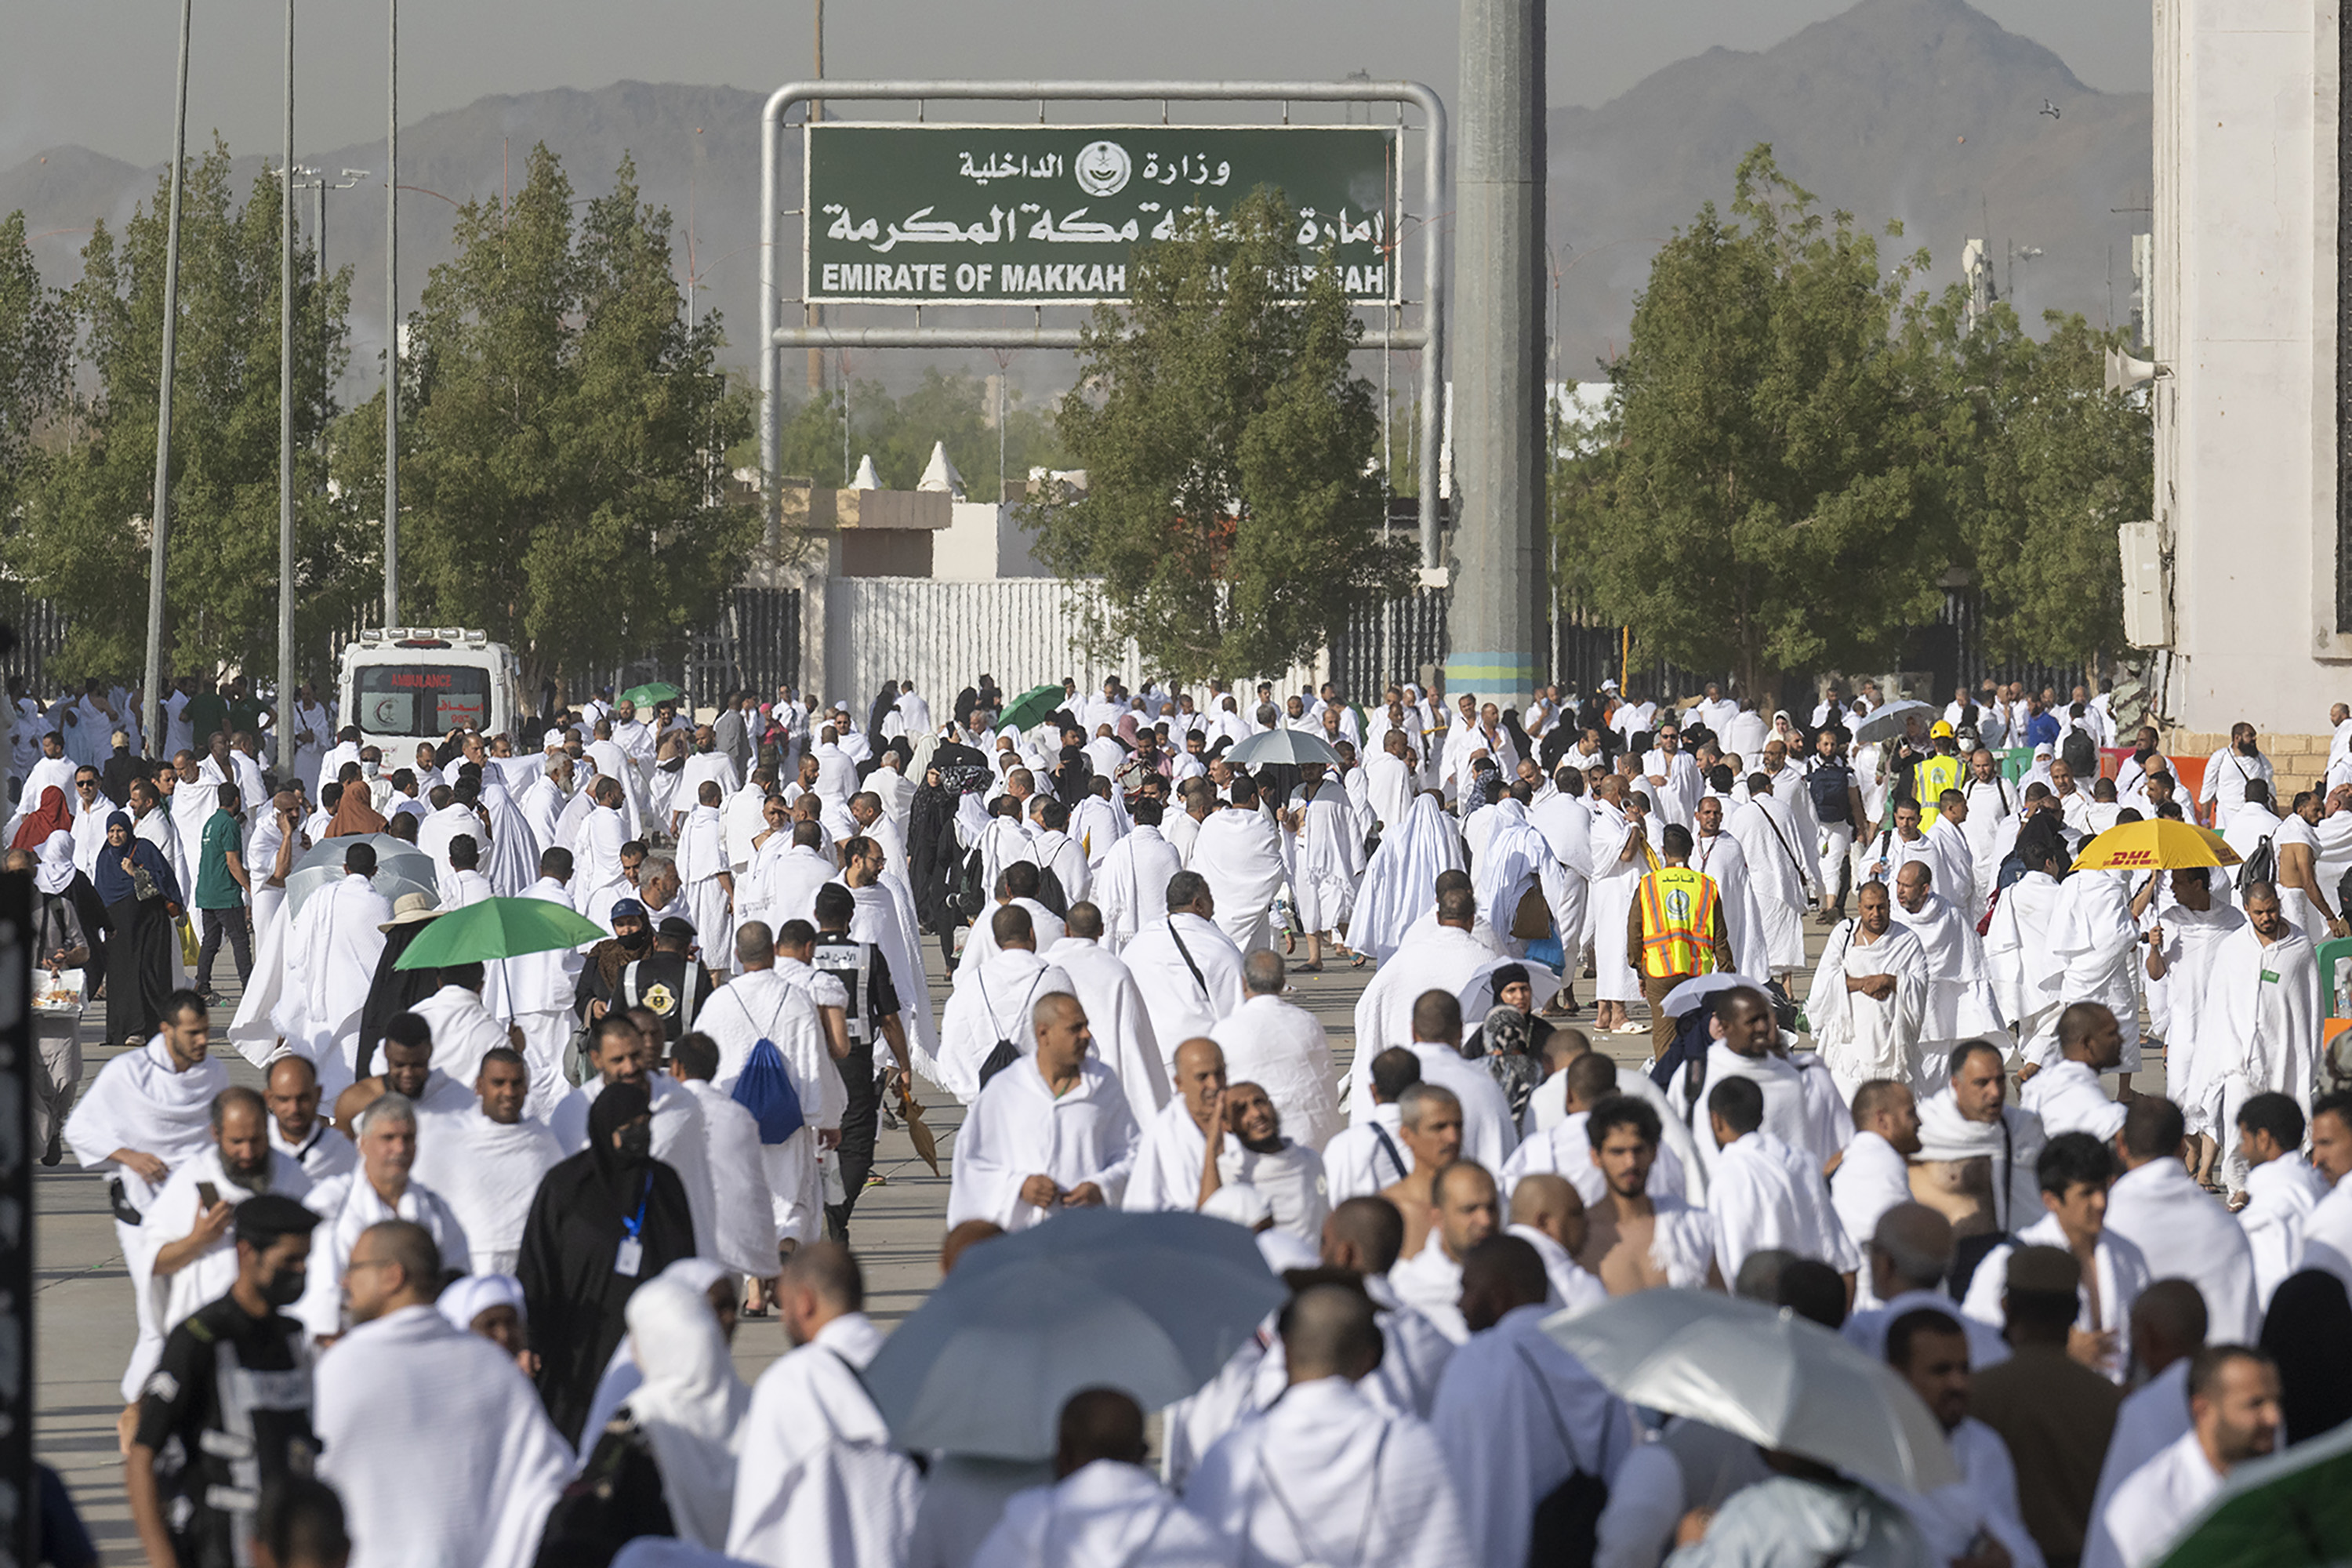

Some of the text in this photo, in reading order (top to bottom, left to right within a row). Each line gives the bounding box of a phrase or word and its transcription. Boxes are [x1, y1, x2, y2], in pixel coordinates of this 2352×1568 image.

[958, 151, 1231, 187] وزارة الداخلية
[822, 203, 1017, 253] المكرمة
[1020, 201, 1140, 243] مكة
[1297, 205, 1385, 256] إمارة
[822, 263, 947, 292] EMIRATE
[955, 263, 993, 292] OF
[1001, 263, 1127, 293] MAKKAH
[390, 673, 452, 688] AMBULANCE
[437, 699, 484, 715] إسعاف
[2109, 850, 2154, 866] DHL
